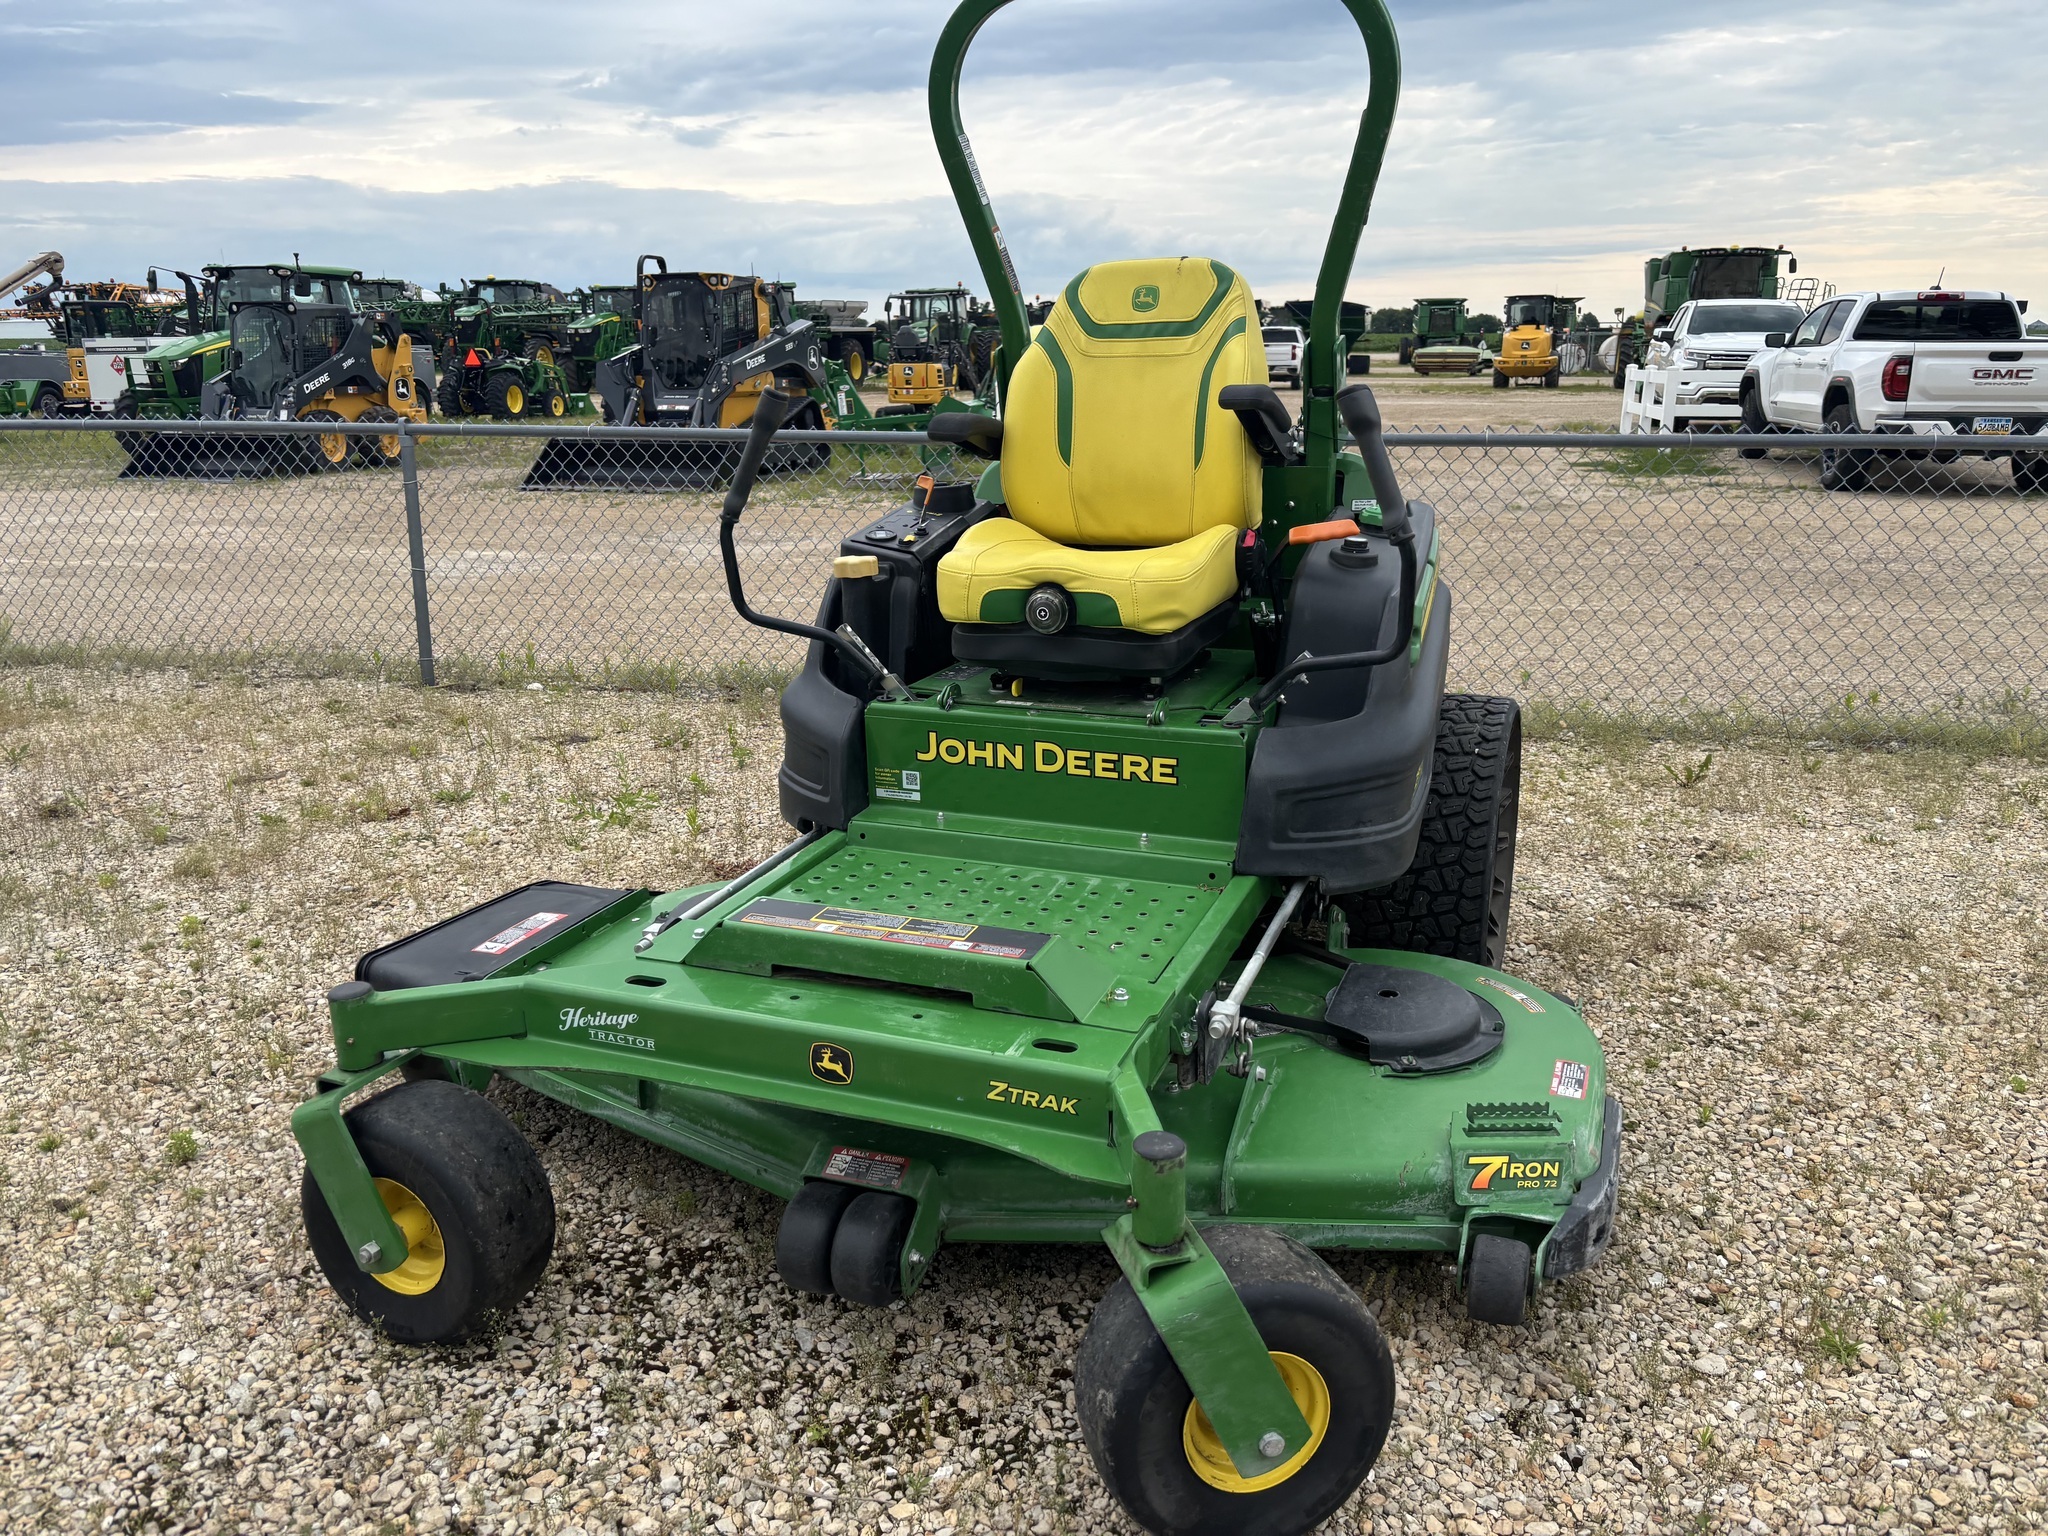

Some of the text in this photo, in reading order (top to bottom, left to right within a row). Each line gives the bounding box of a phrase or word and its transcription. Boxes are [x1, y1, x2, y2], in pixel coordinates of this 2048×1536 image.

[341, 356, 356, 370] 318G
[745, 353, 766, 370] DEERE
[1973, 368, 2034, 380] GMC
[302, 372, 331, 394] DEERE
[916, 730, 1179, 786] JOHN DEERE
[559, 1006, 639, 1031] Heritage
[589, 1030, 656, 1049] TRACTOR
[882, 1154, 905, 1164] PELIGRO
[1517, 1179, 1558, 1189] PRO 72
